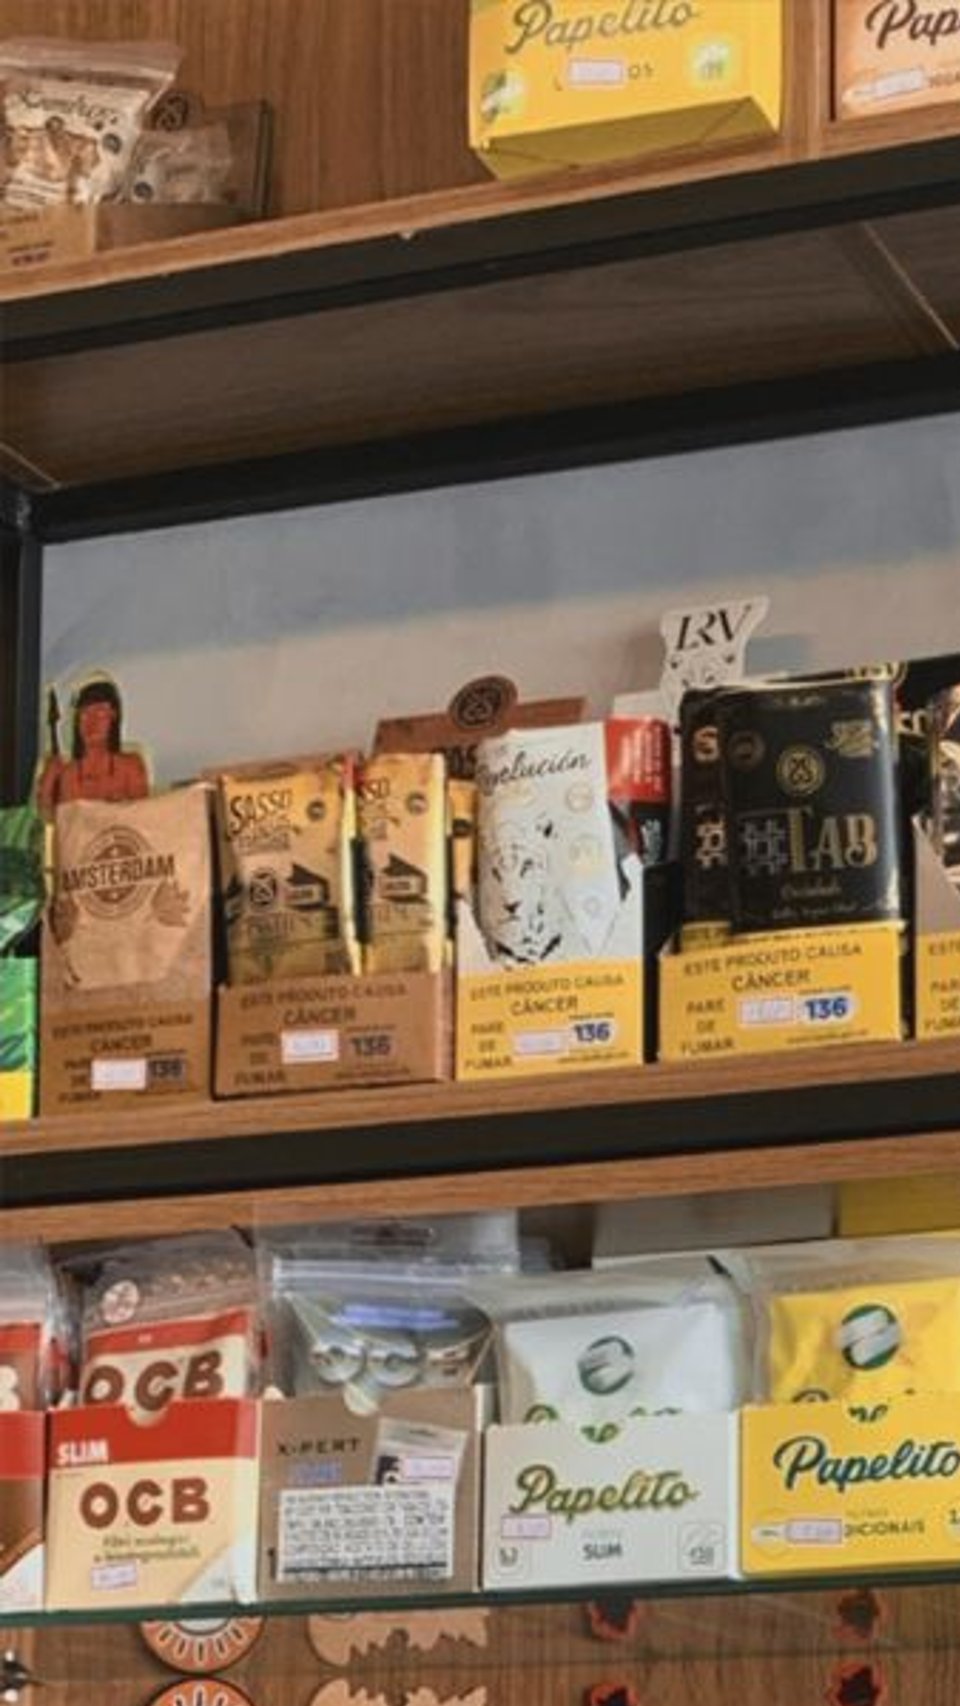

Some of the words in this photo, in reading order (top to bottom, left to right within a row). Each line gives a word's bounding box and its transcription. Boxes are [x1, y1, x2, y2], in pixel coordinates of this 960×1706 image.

[61, 853, 175, 893] AMSTERDAM
[804, 995, 849, 1021] 136
[351, 1034, 391, 1057] 136
[573, 1022, 611, 1043] 136
[84, 1349, 225, 1412] OCB
[57, 1438, 110, 1467] SLIM
[79, 1476, 211, 1531] OCB
[508, 1463, 700, 1525] Papelito
[582, 1542, 624, 1562] SLIM
